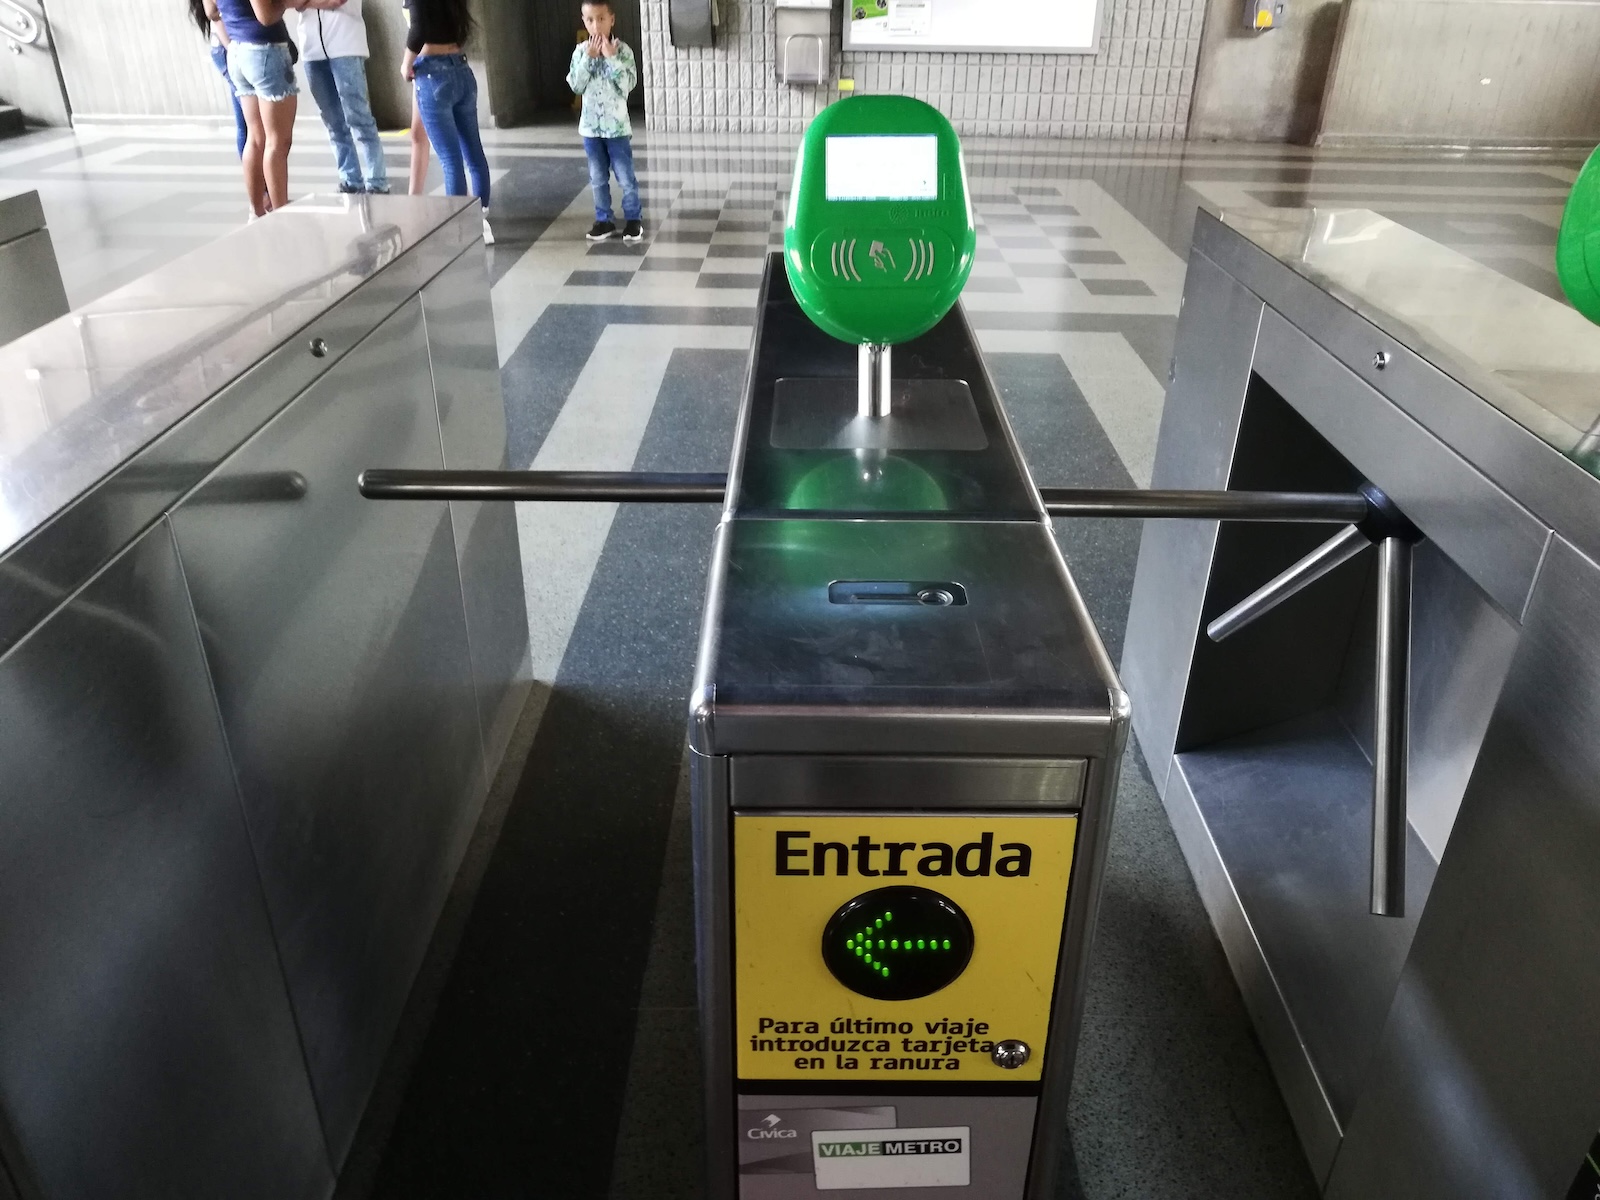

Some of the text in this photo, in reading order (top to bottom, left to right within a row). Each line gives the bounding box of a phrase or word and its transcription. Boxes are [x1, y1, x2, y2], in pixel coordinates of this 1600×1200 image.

[776, 831, 1032, 877] Entrada
[758, 1017, 989, 1038] Para último viaje
[750, 1036, 994, 1055] introduzca tarjeta
[794, 1055, 960, 1070] en la ranura
[820, 1140, 960, 1156] VIAJE METRO
